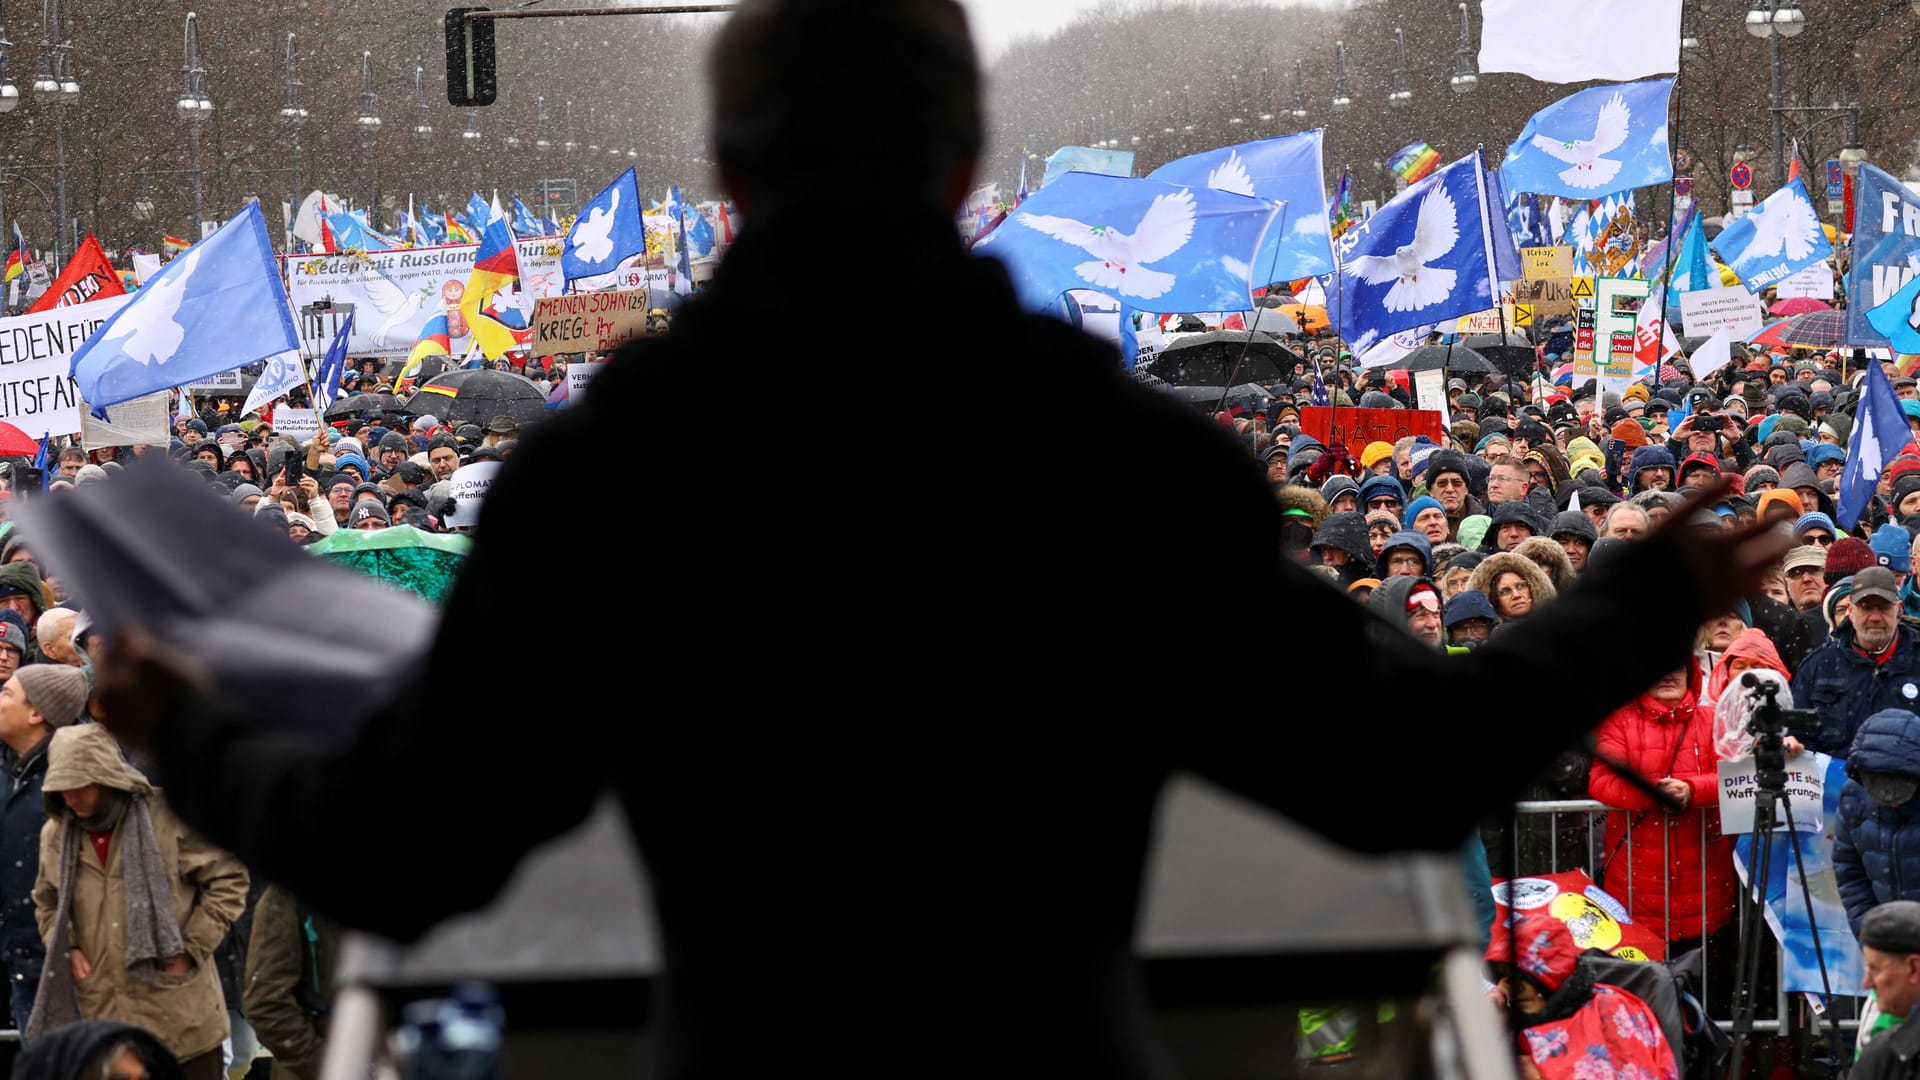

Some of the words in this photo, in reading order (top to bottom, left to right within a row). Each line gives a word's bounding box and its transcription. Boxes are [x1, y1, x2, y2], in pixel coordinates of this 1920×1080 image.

[400, 272, 420, 280] gegen
[643, 272, 669, 281] ARMY
[538, 293, 587, 318] MEINEN
[590, 292, 627, 313] SOHN
[628, 291, 647, 312] (25)
[1686, 309, 1709, 317] MORGEN
[596, 316, 616, 336] ihr
[1579, 330, 1591, 338] die
[1578, 341, 1591, 349] die
